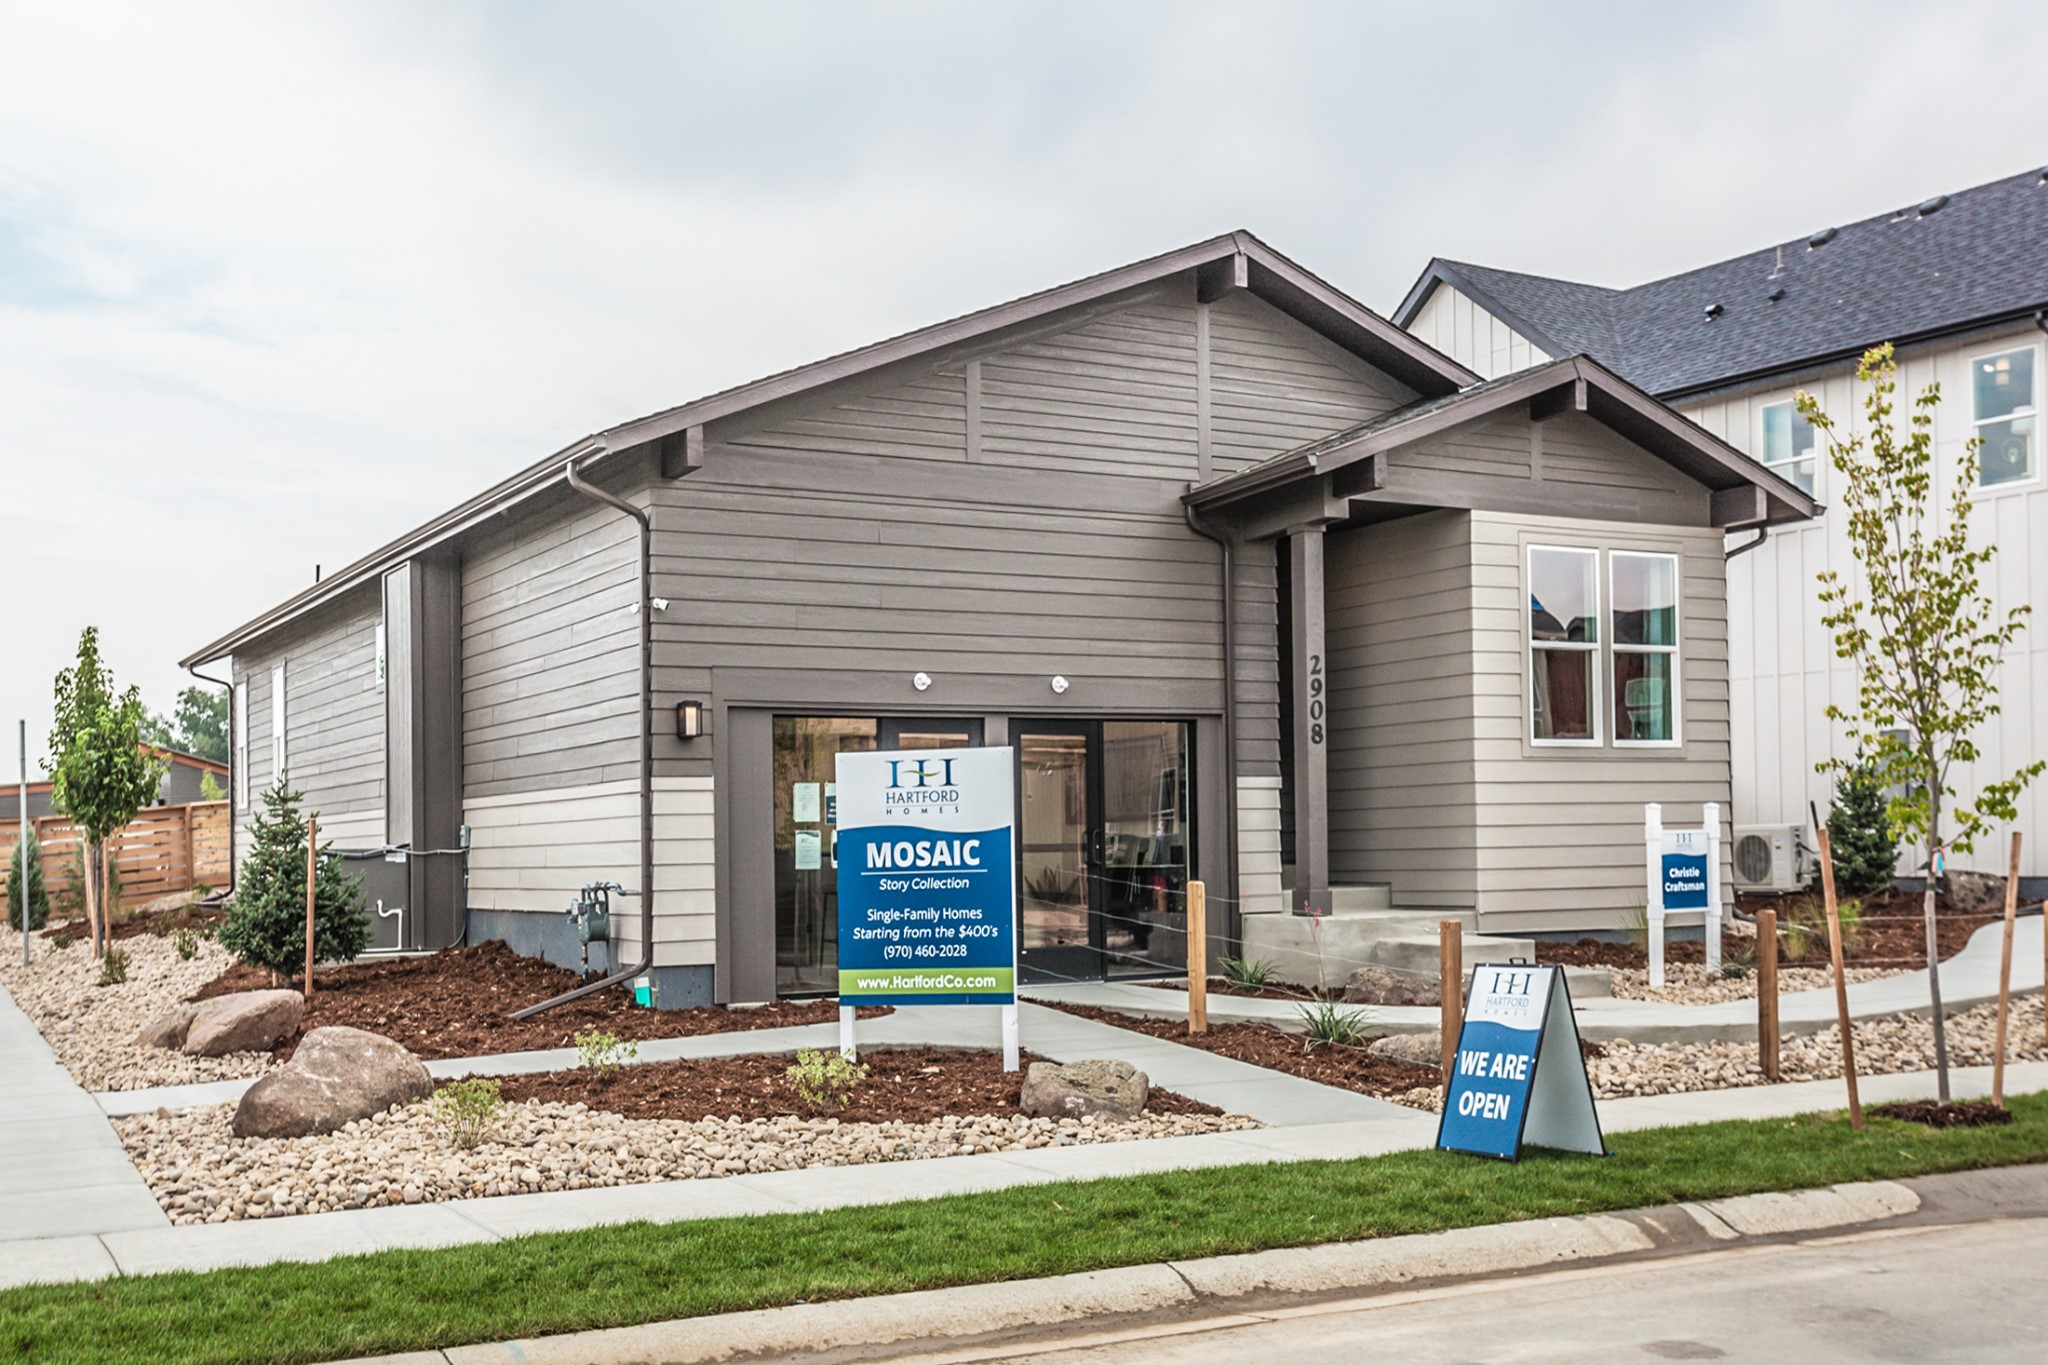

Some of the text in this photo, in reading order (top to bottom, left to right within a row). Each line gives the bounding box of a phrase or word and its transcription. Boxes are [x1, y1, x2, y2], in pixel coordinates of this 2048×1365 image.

[1310, 654, 1324, 745] 2908
[886, 789, 959, 804] HARTFORD
[886, 806, 959, 815] HOMES
[866, 839, 981, 869] MOSAIC
[1669, 866, 1700, 878] Christie
[879, 876, 970, 893] Story Collection
[1664, 881, 1705, 892] Craftsman
[867, 907, 983, 924] Single-Family Homes
[853, 924, 999, 942] Starting from the $400's
[883, 944, 968, 960] (970) 460-2028
[857, 974, 997, 990] www.HartfordCo.com
[1486, 996, 1530, 1008] HARTFORD
[1460, 1050, 1530, 1081] WE ARE
[1458, 1090, 1511, 1121] OPEN
